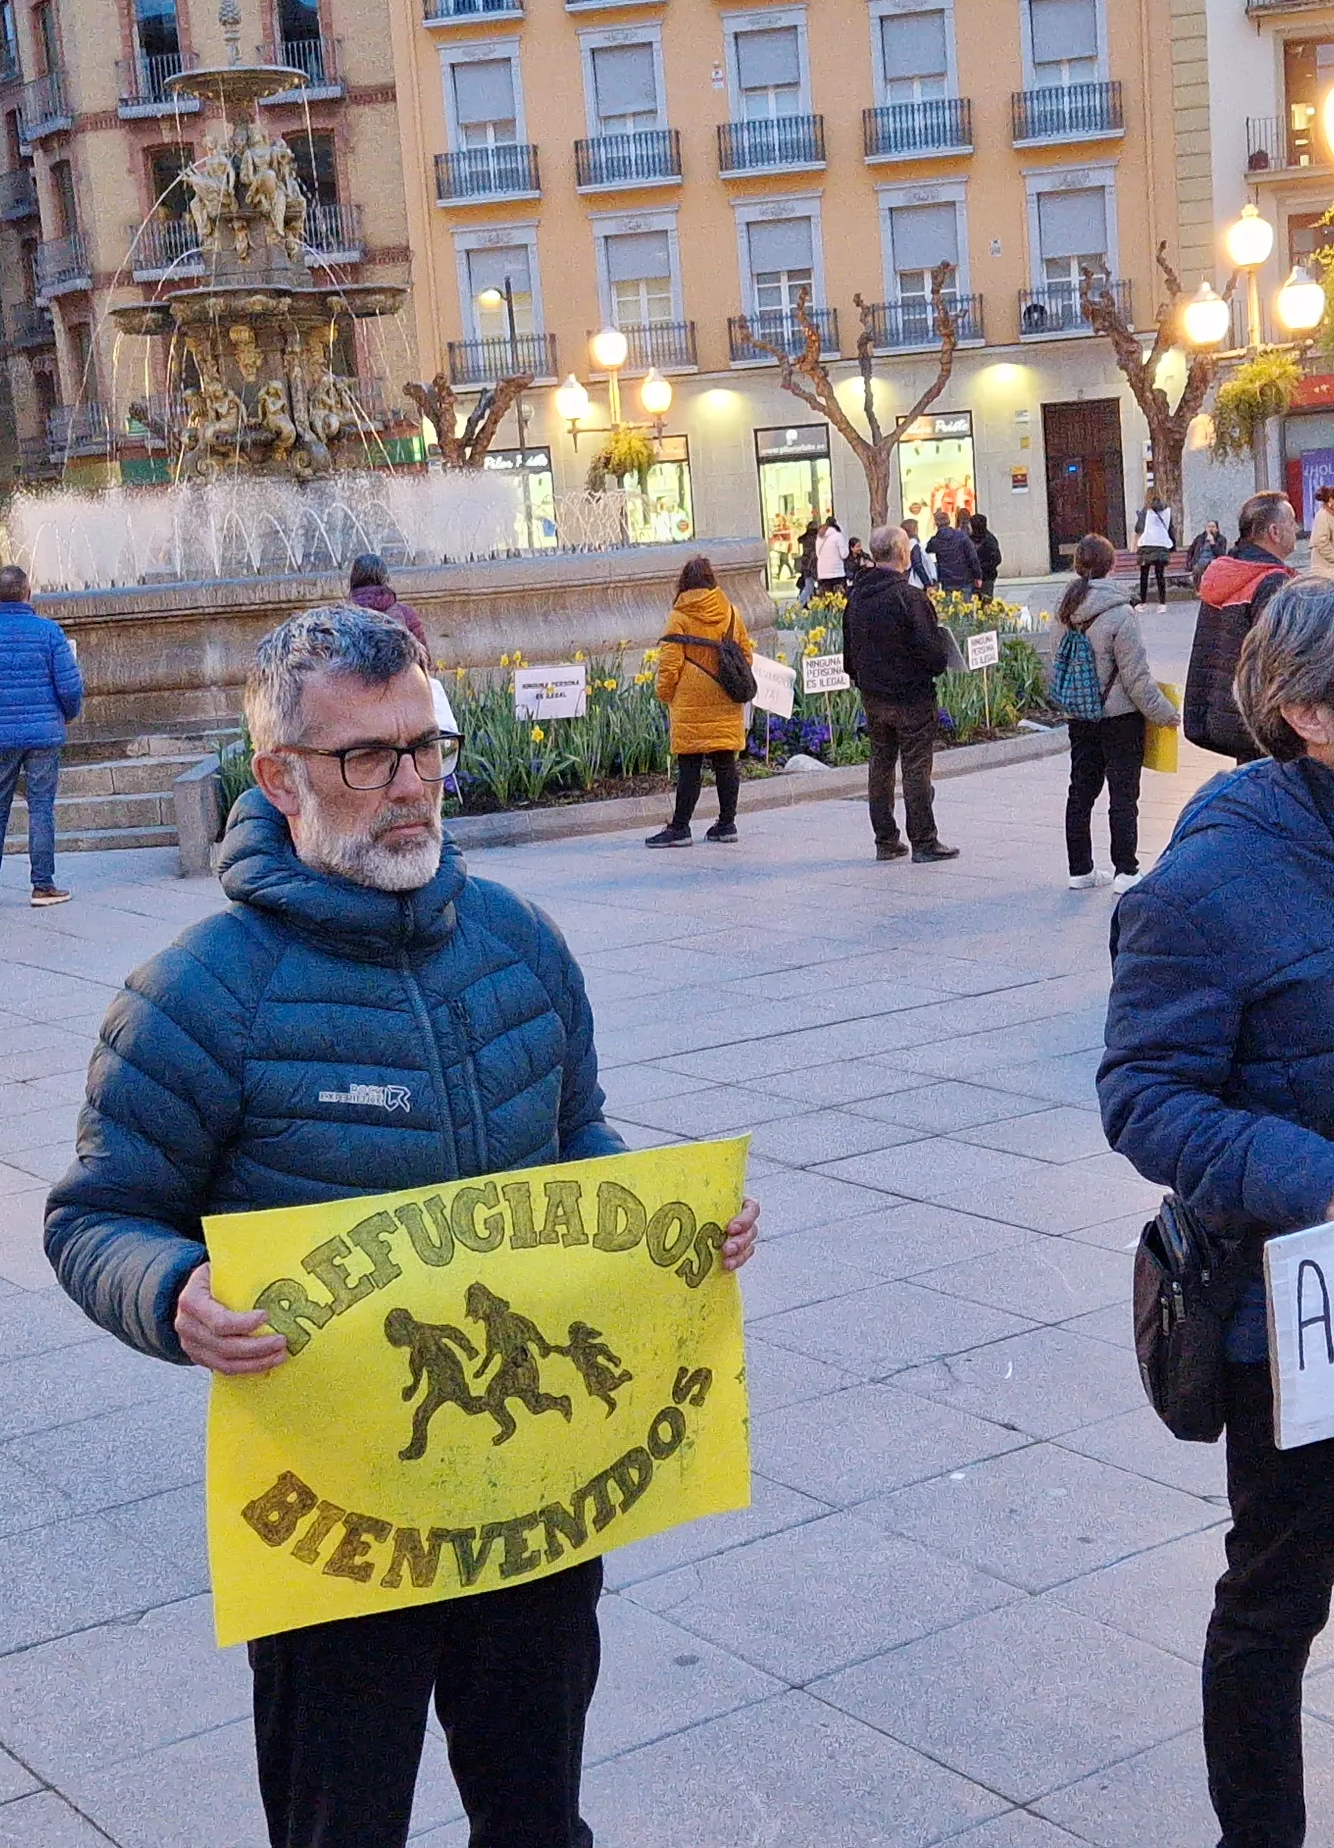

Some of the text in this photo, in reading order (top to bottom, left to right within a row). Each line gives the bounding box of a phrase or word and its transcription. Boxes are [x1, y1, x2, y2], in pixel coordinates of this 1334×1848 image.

[806, 657, 842, 668] NINGUNA
[807, 667, 845, 678] PERSONA
[806, 677, 847, 689] ES ILEGAL
[254, 1180, 727, 1357] REFUGIADOS
[242, 1365, 713, 1590] BIENVENIDOS
